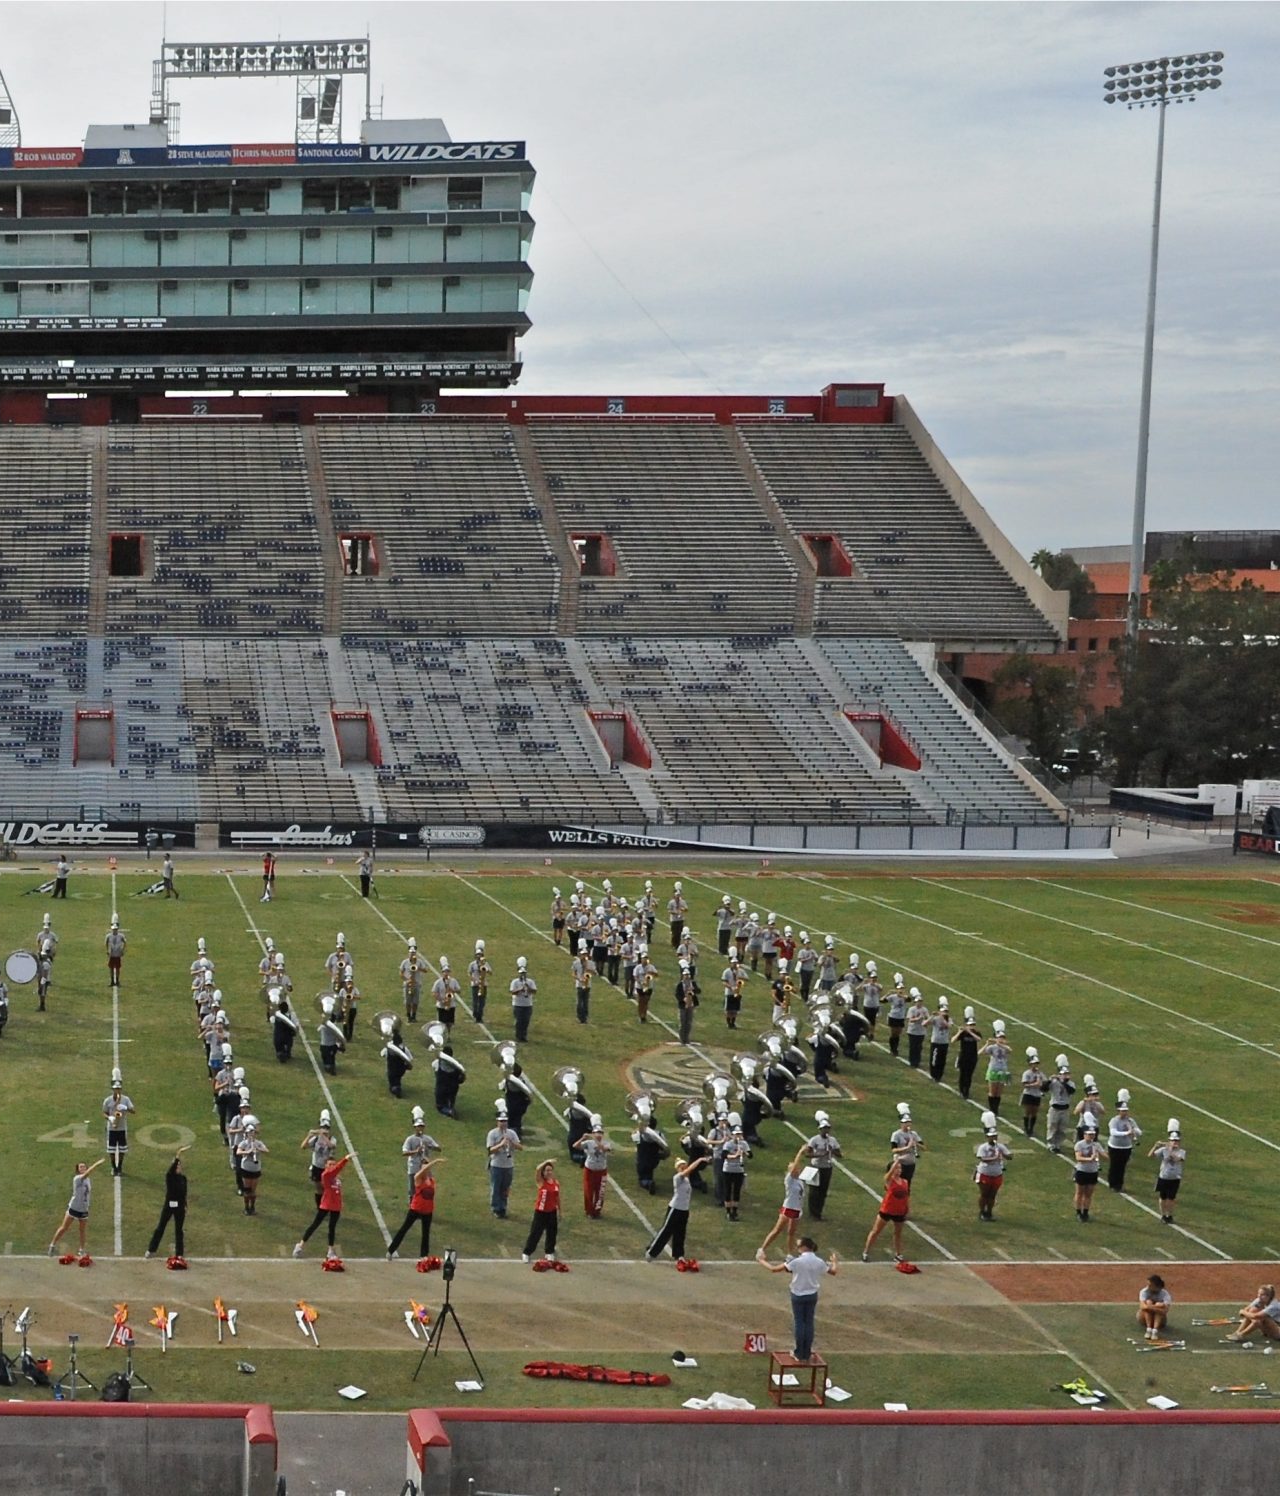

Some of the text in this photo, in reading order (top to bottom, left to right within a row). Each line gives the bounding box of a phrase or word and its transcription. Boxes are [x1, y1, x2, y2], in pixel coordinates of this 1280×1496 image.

[24, 153, 39, 161] ROB
[40, 153, 76, 161] WALDROP
[177, 150, 194, 158] STEVE
[195, 150, 232, 158] McLAUGHLIN
[239, 149, 260, 157] CHRIS
[260, 149, 296, 157] McALISTER
[303, 148, 333, 157] ANTOINE
[334, 148, 359, 157] CASON
[369, 144, 517, 160] WILDCATS
[193, 404, 207, 415] 22
[421, 404, 436, 415] 23
[608, 404, 623, 415] 24
[769, 404, 784, 415] 25
[442, 830, 479, 839] CASINOS
[548, 830, 608, 844] WELLS
[36, 1123, 197, 1150] 40
[115, 1325, 130, 1345] 40
[749, 1334, 766, 1353] 30
